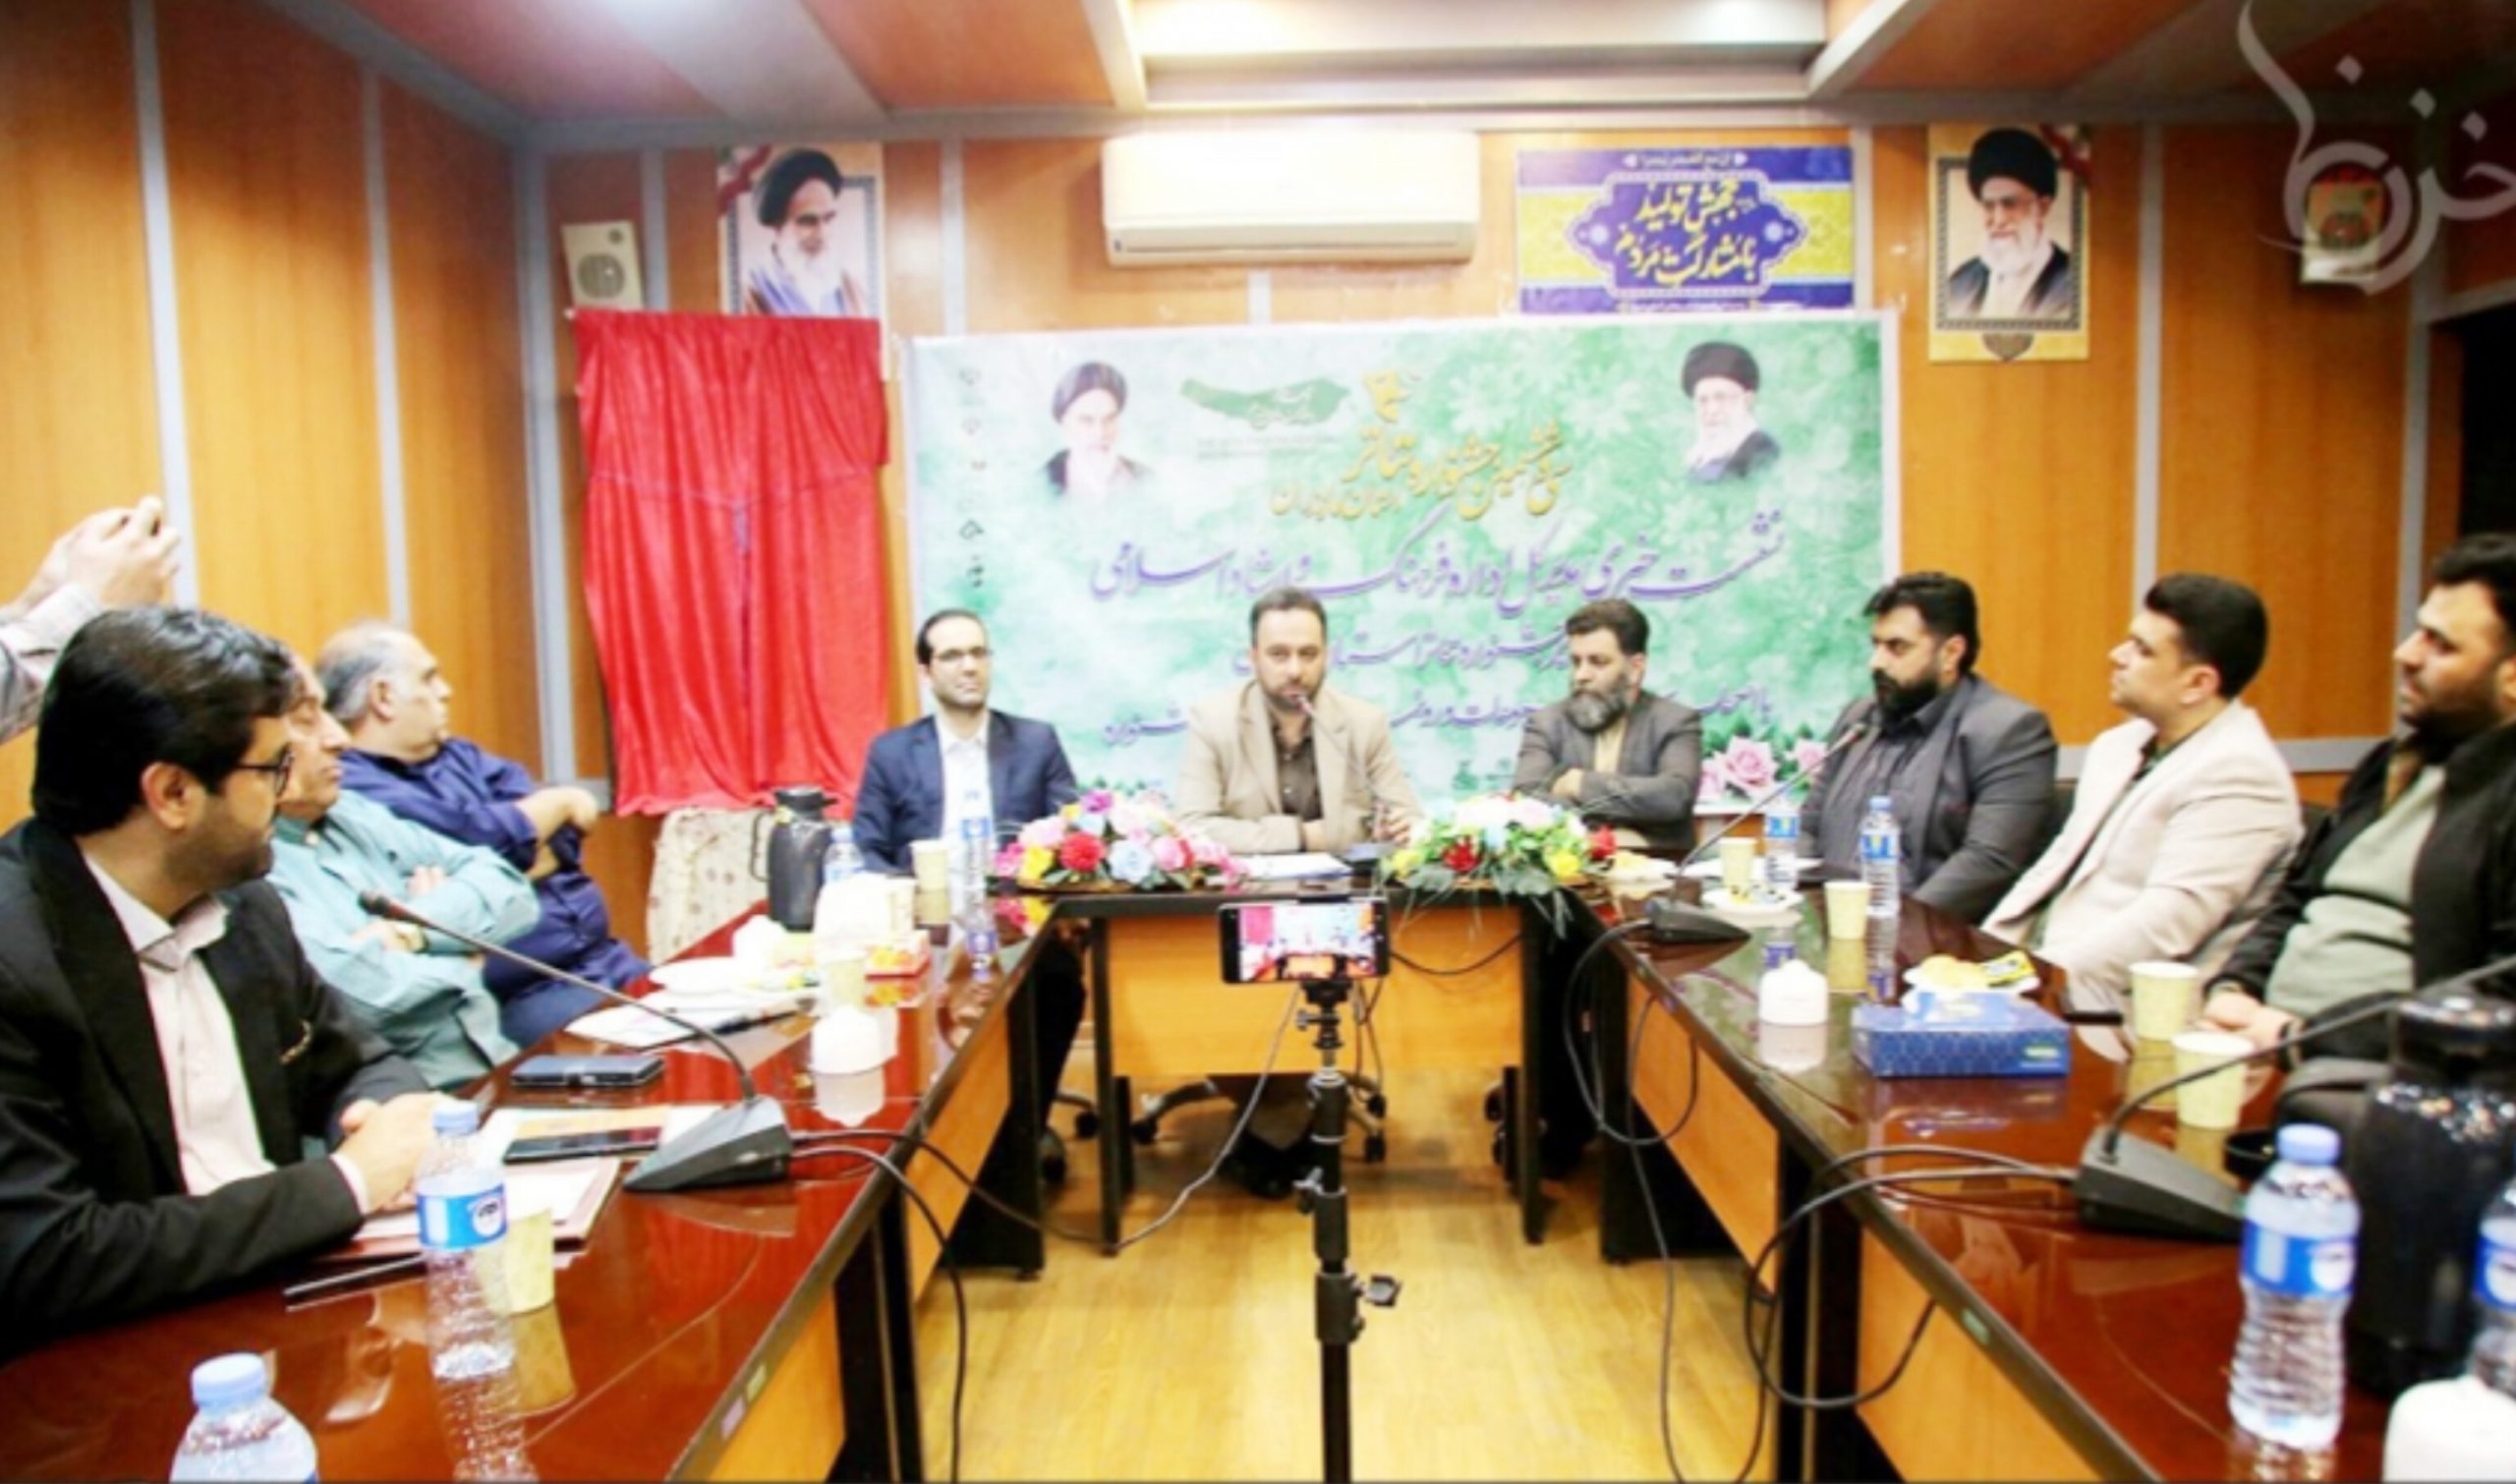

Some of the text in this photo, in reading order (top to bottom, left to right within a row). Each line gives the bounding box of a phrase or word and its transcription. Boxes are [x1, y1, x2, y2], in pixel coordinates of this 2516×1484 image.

[1635, 182, 1693, 231] تولید
[1088, 541, 1240, 603] اسلامی
[1579, 532, 1662, 601] خبری
[1626, 507, 1787, 599] نشست
